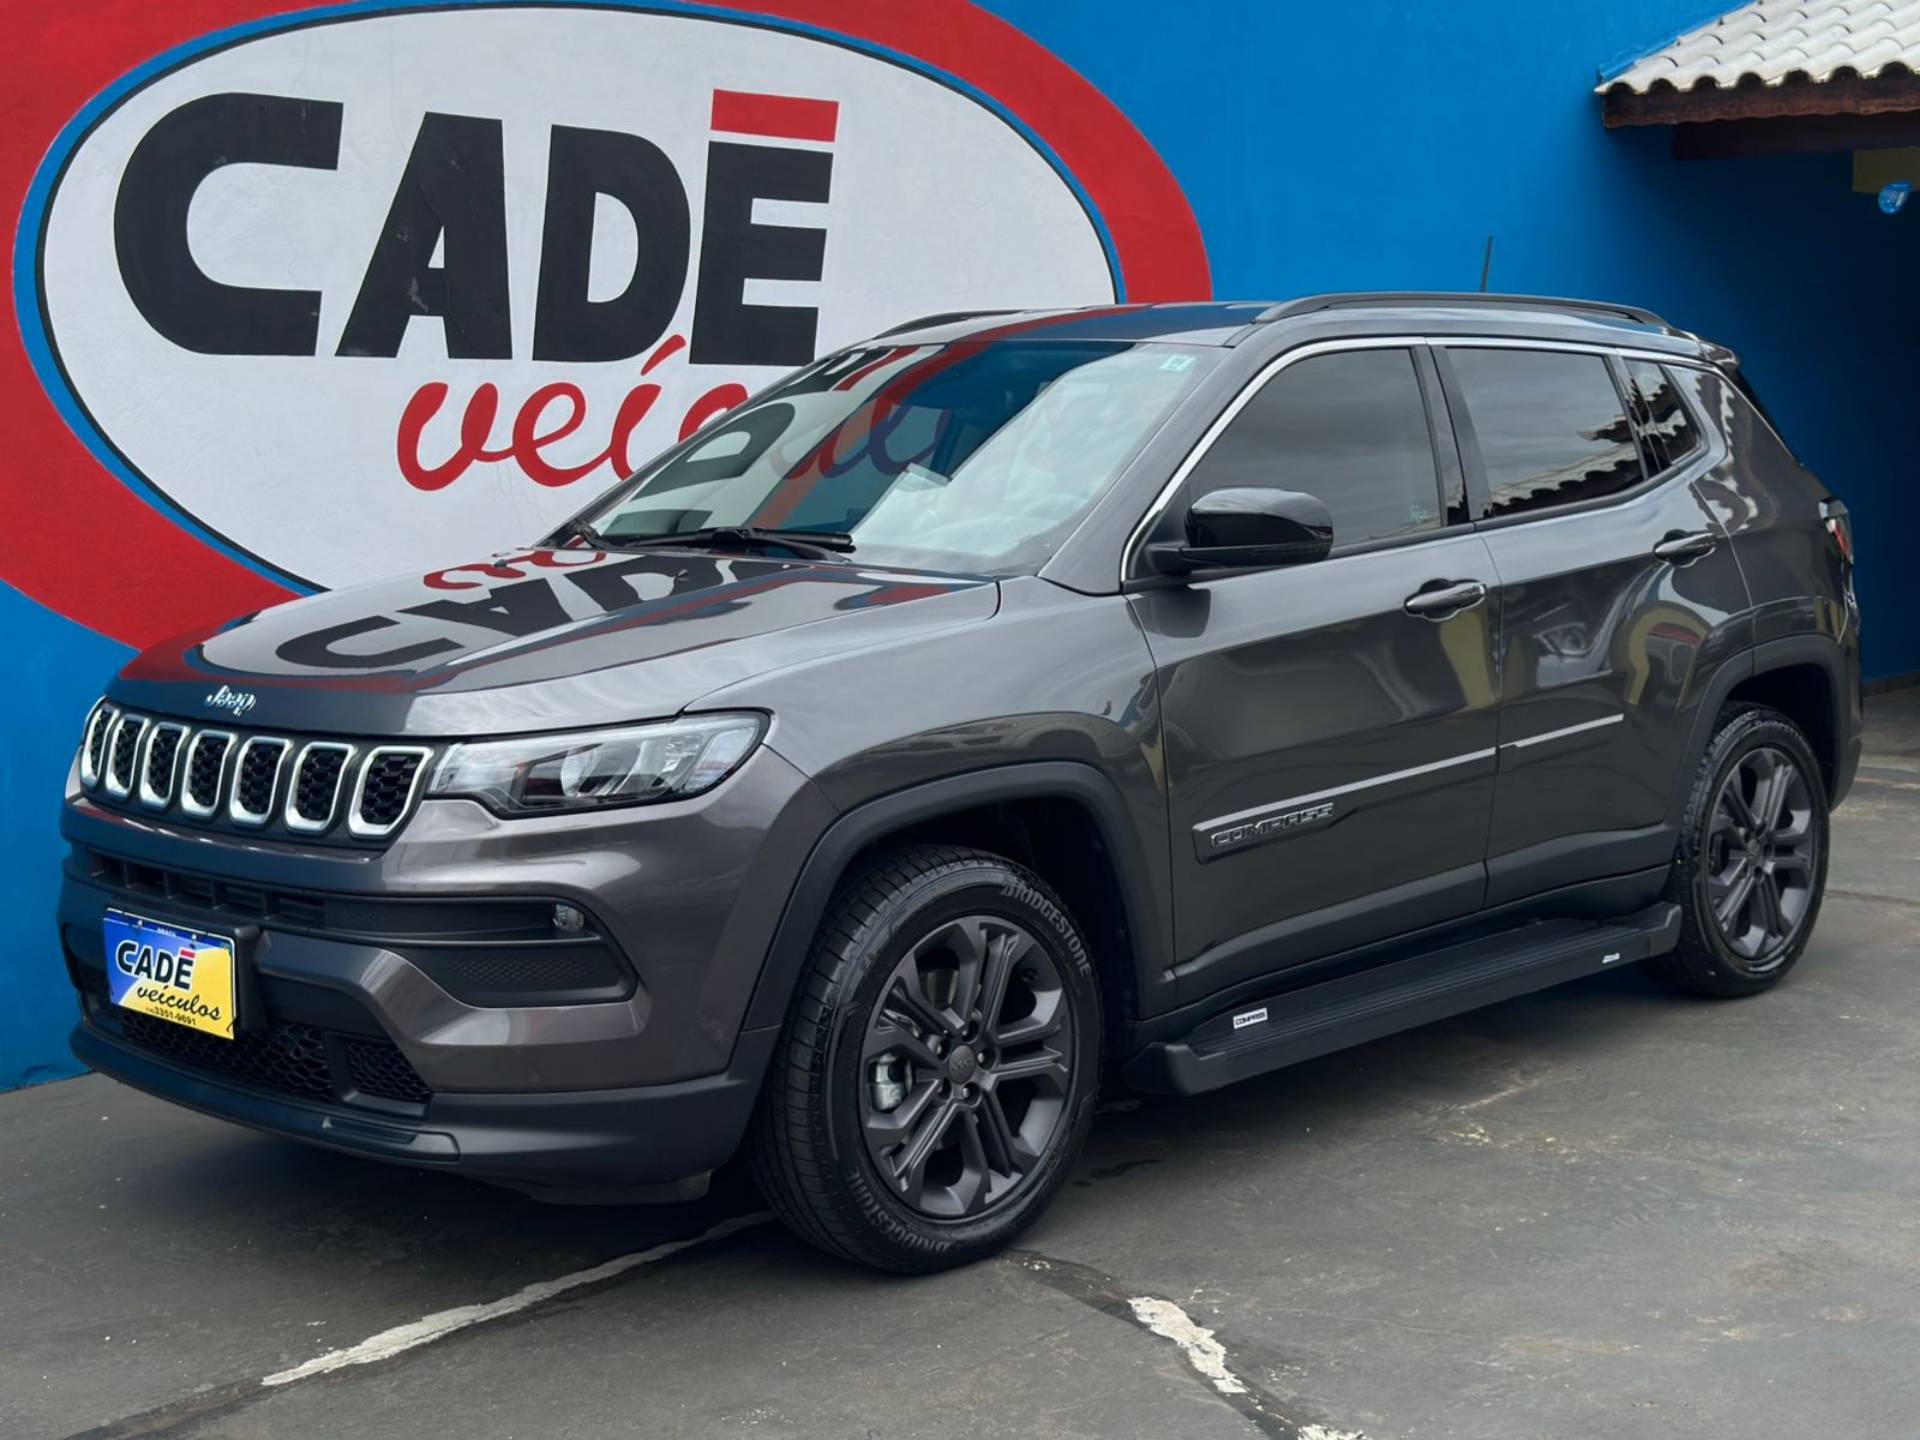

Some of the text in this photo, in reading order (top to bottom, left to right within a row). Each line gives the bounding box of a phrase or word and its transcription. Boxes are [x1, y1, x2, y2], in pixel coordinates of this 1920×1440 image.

[204, 685, 256, 716] Jeep
[1211, 802, 1334, 848] COMPASS
[1000, 874, 1092, 977] BRIDGESTONE
